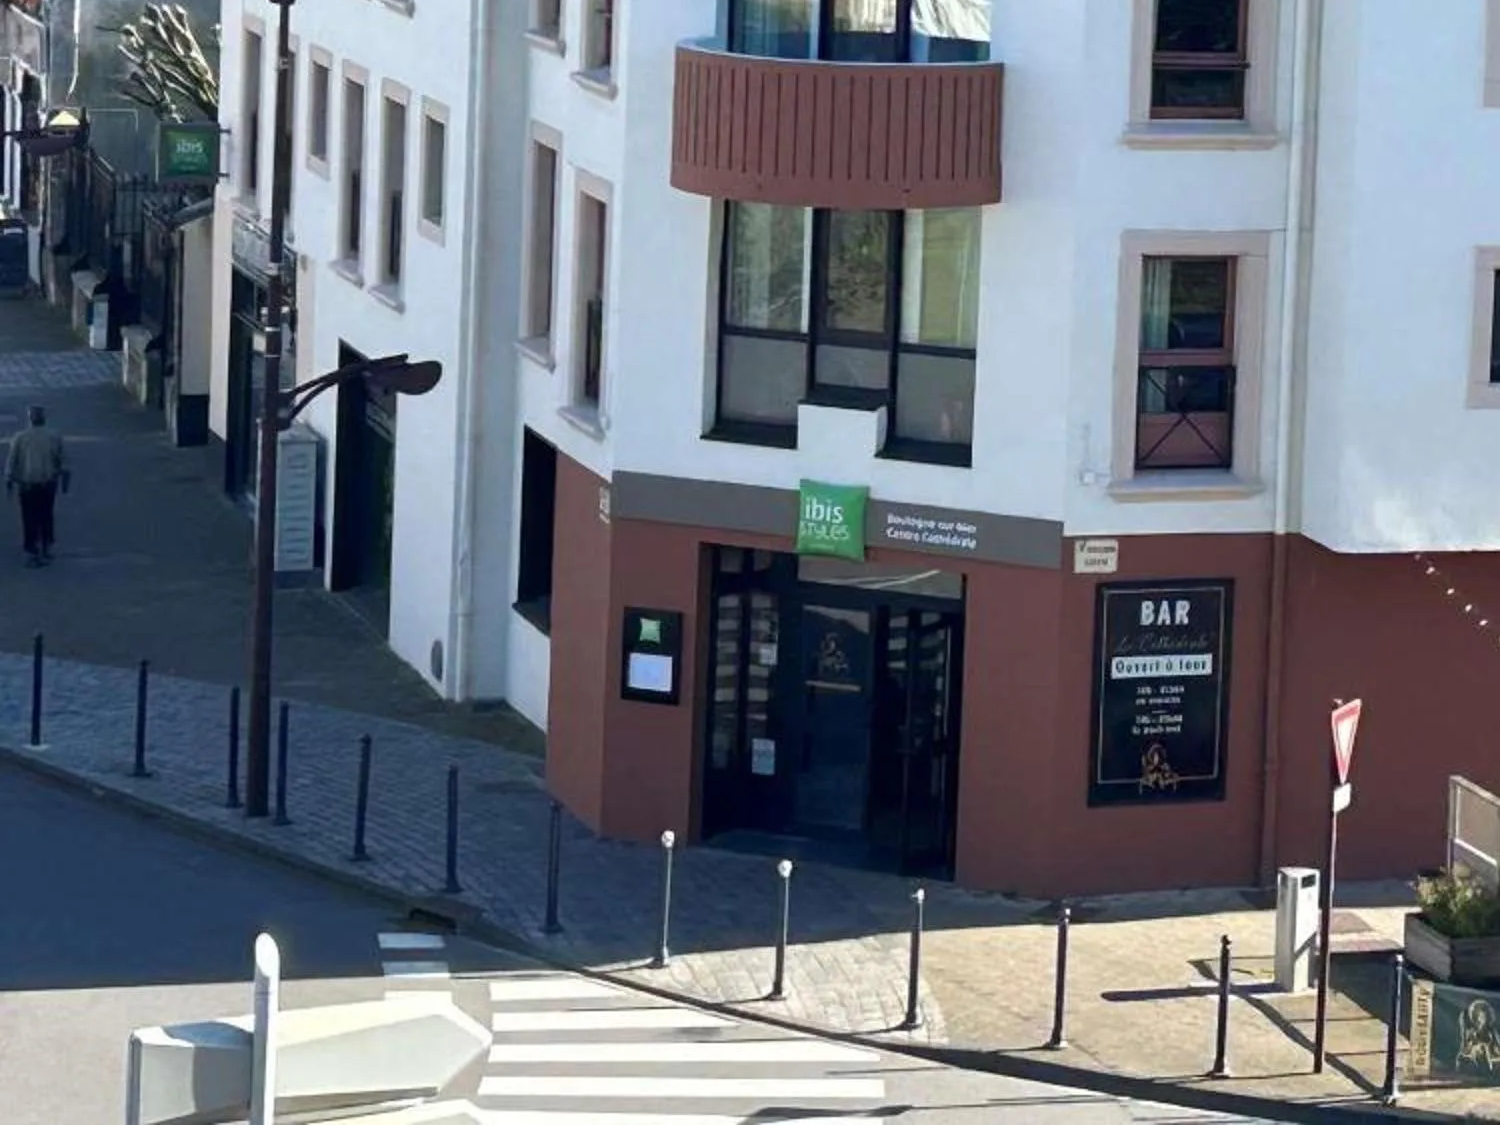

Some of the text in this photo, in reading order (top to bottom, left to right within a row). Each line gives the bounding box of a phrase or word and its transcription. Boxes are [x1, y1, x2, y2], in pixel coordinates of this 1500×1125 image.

[805, 497, 844, 524] ibis
[800, 520, 850, 542] STYLES
[1140, 599, 1190, 626] BAR
